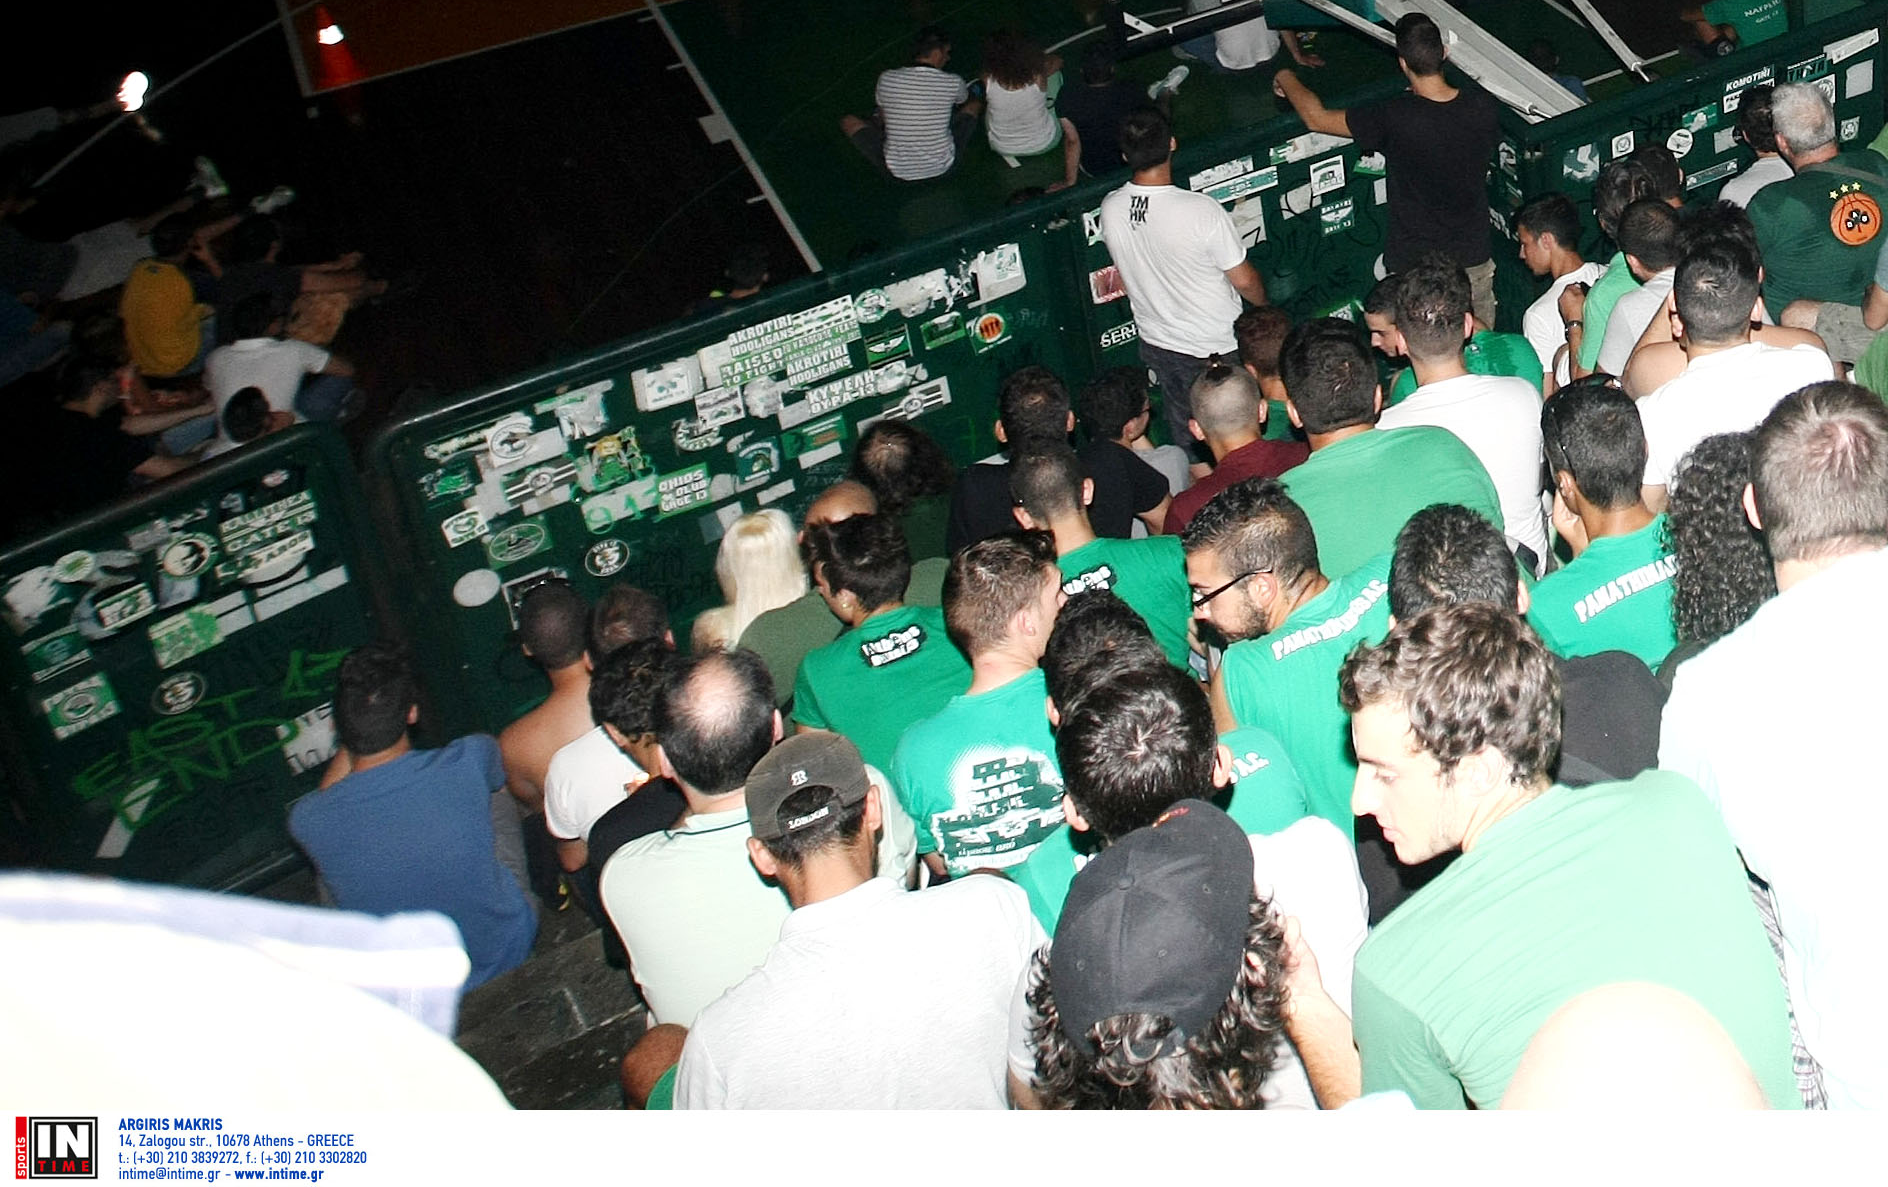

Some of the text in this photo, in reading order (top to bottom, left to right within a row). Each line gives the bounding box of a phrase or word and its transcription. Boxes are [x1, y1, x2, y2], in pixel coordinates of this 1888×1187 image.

[1130, 195, 1149, 209] TM
[729, 314, 792, 346] AKROTIRI
[731, 329, 795, 357] HOOLIGANS
[722, 348, 783, 378] RAISED
[786, 344, 848, 376] AKROTIRI
[788, 356, 852, 386] HOOLIGANS
[807, 371, 875, 403] ΚΥΨΕΛΗ
[226, 521, 290, 553] GATE
